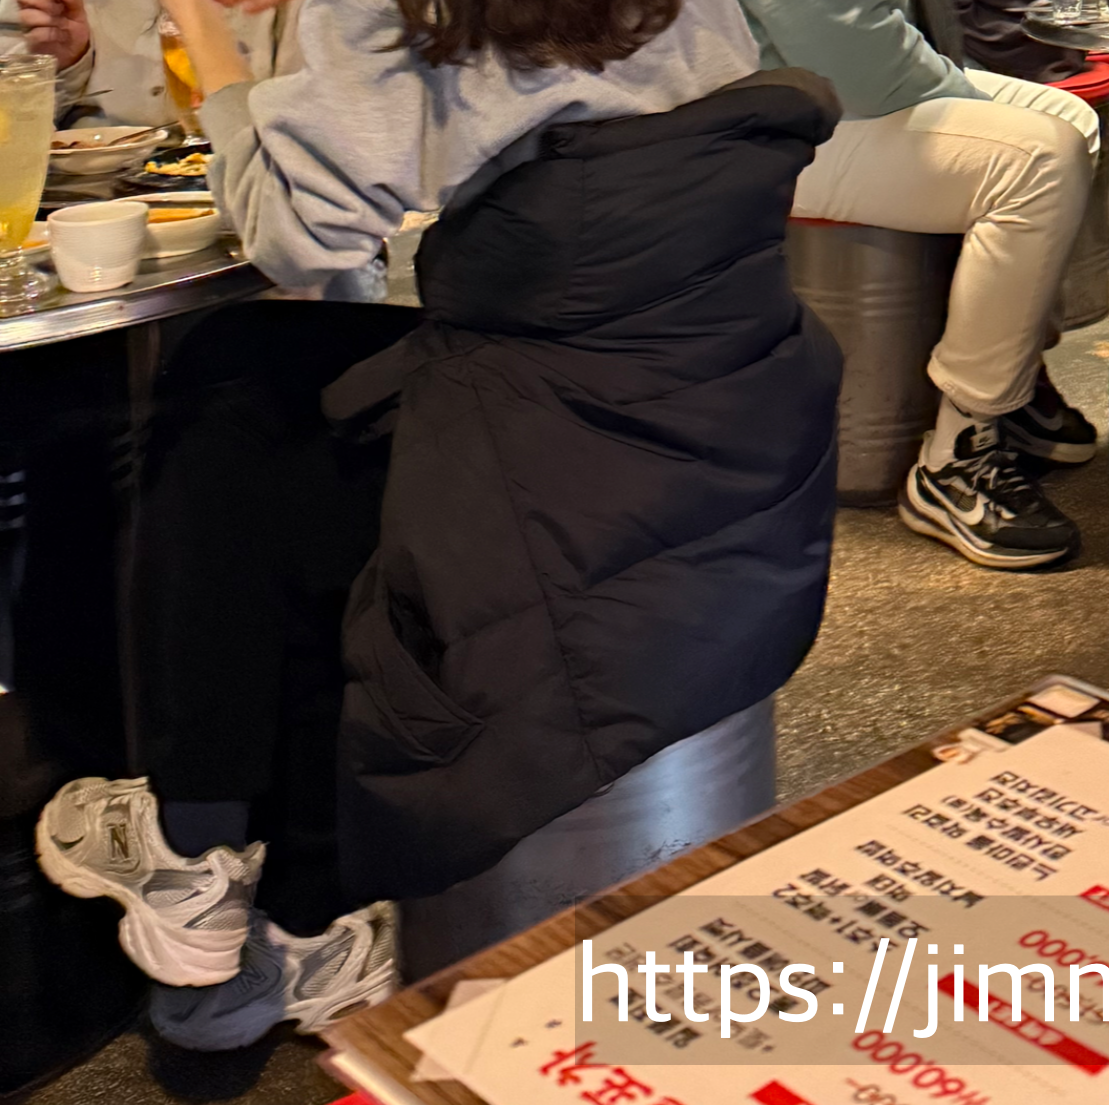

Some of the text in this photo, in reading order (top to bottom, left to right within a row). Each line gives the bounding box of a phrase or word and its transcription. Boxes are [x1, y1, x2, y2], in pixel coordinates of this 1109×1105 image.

[901, 802, 1057, 881] 느린마을 막걸리
[973, 786, 1083, 842] 새우부추전
[854, 837, 984, 908] 날치알주먹밥
[862, 872, 916, 903] 먹태
